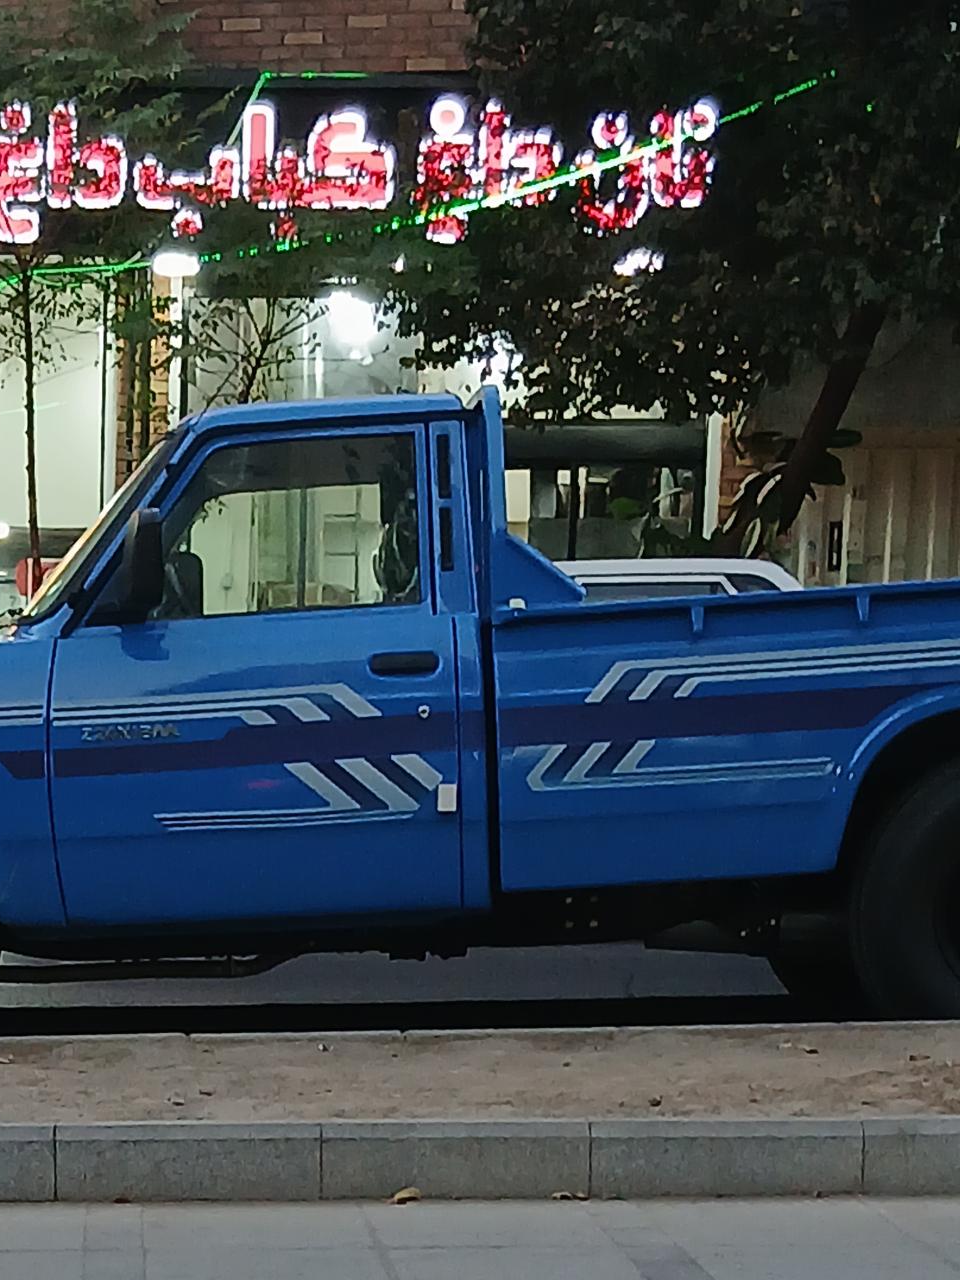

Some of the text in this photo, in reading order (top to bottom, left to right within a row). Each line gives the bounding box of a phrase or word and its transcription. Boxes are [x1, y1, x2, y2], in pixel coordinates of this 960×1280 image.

[134, 99, 396, 240] کباب
[414, 94, 563, 243] داغ
[572, 95, 720, 237] نان
